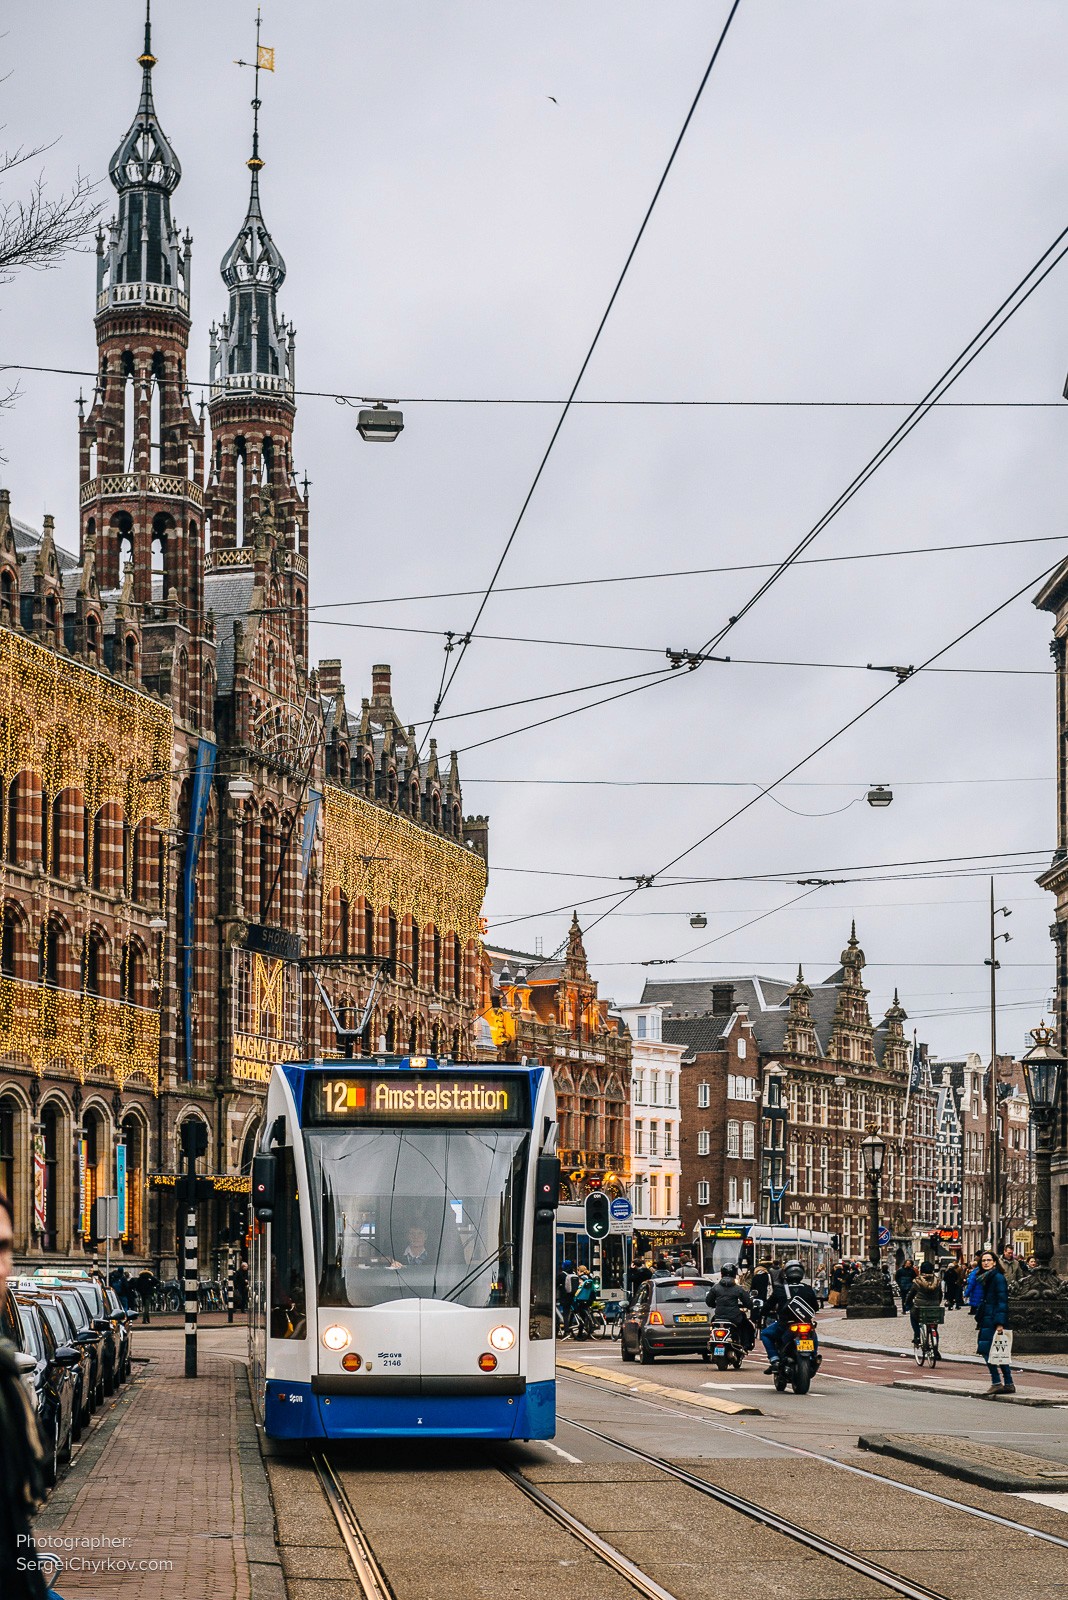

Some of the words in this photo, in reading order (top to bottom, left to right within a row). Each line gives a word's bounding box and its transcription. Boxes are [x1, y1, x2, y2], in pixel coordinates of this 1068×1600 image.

[233, 1033, 268, 1061] MAGNA
[270, 1041, 300, 1064] PLAZA
[233, 1058, 270, 1083] SHOPPING
[322, 1082, 348, 1113] 12
[375, 1083, 508, 1110] Amstelstation
